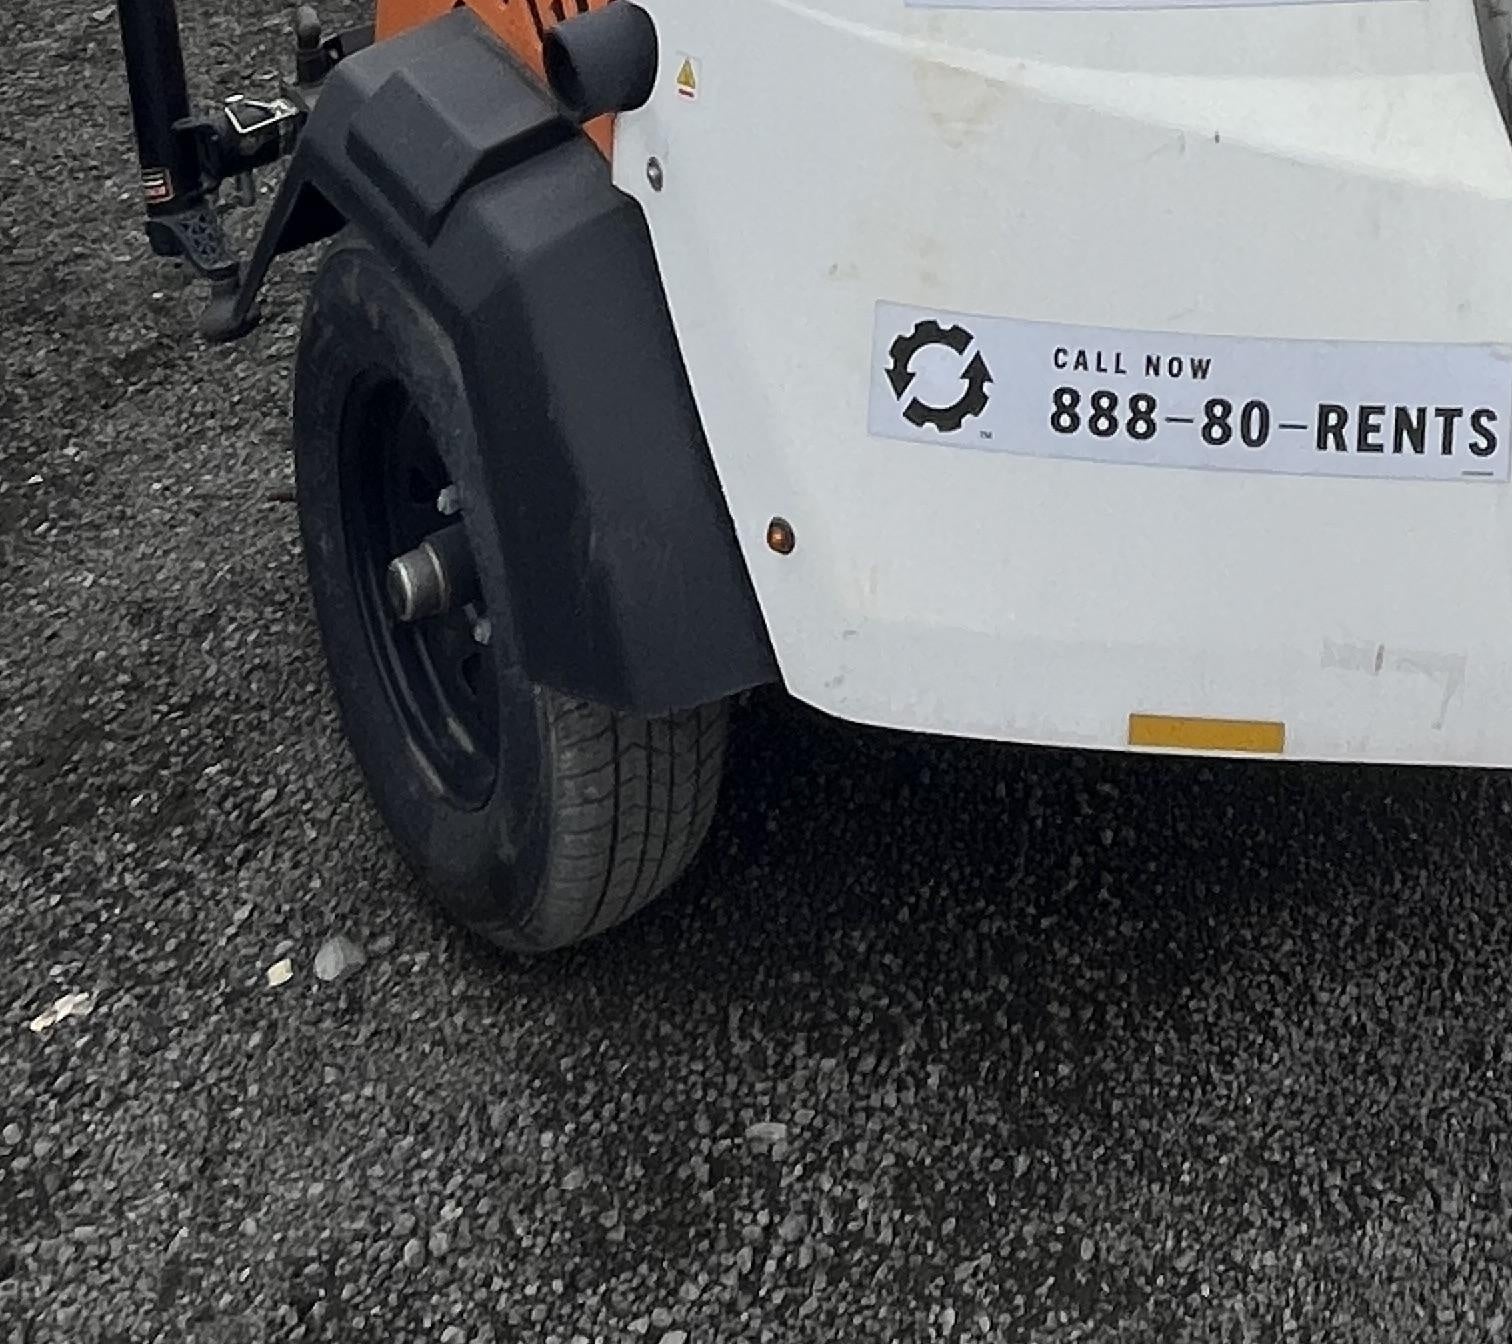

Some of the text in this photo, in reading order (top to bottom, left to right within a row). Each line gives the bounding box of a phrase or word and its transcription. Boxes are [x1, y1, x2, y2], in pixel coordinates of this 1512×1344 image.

[1053, 347, 1213, 381] CALL NOW
[1050, 386, 1499, 458] 888-80-RENTS
